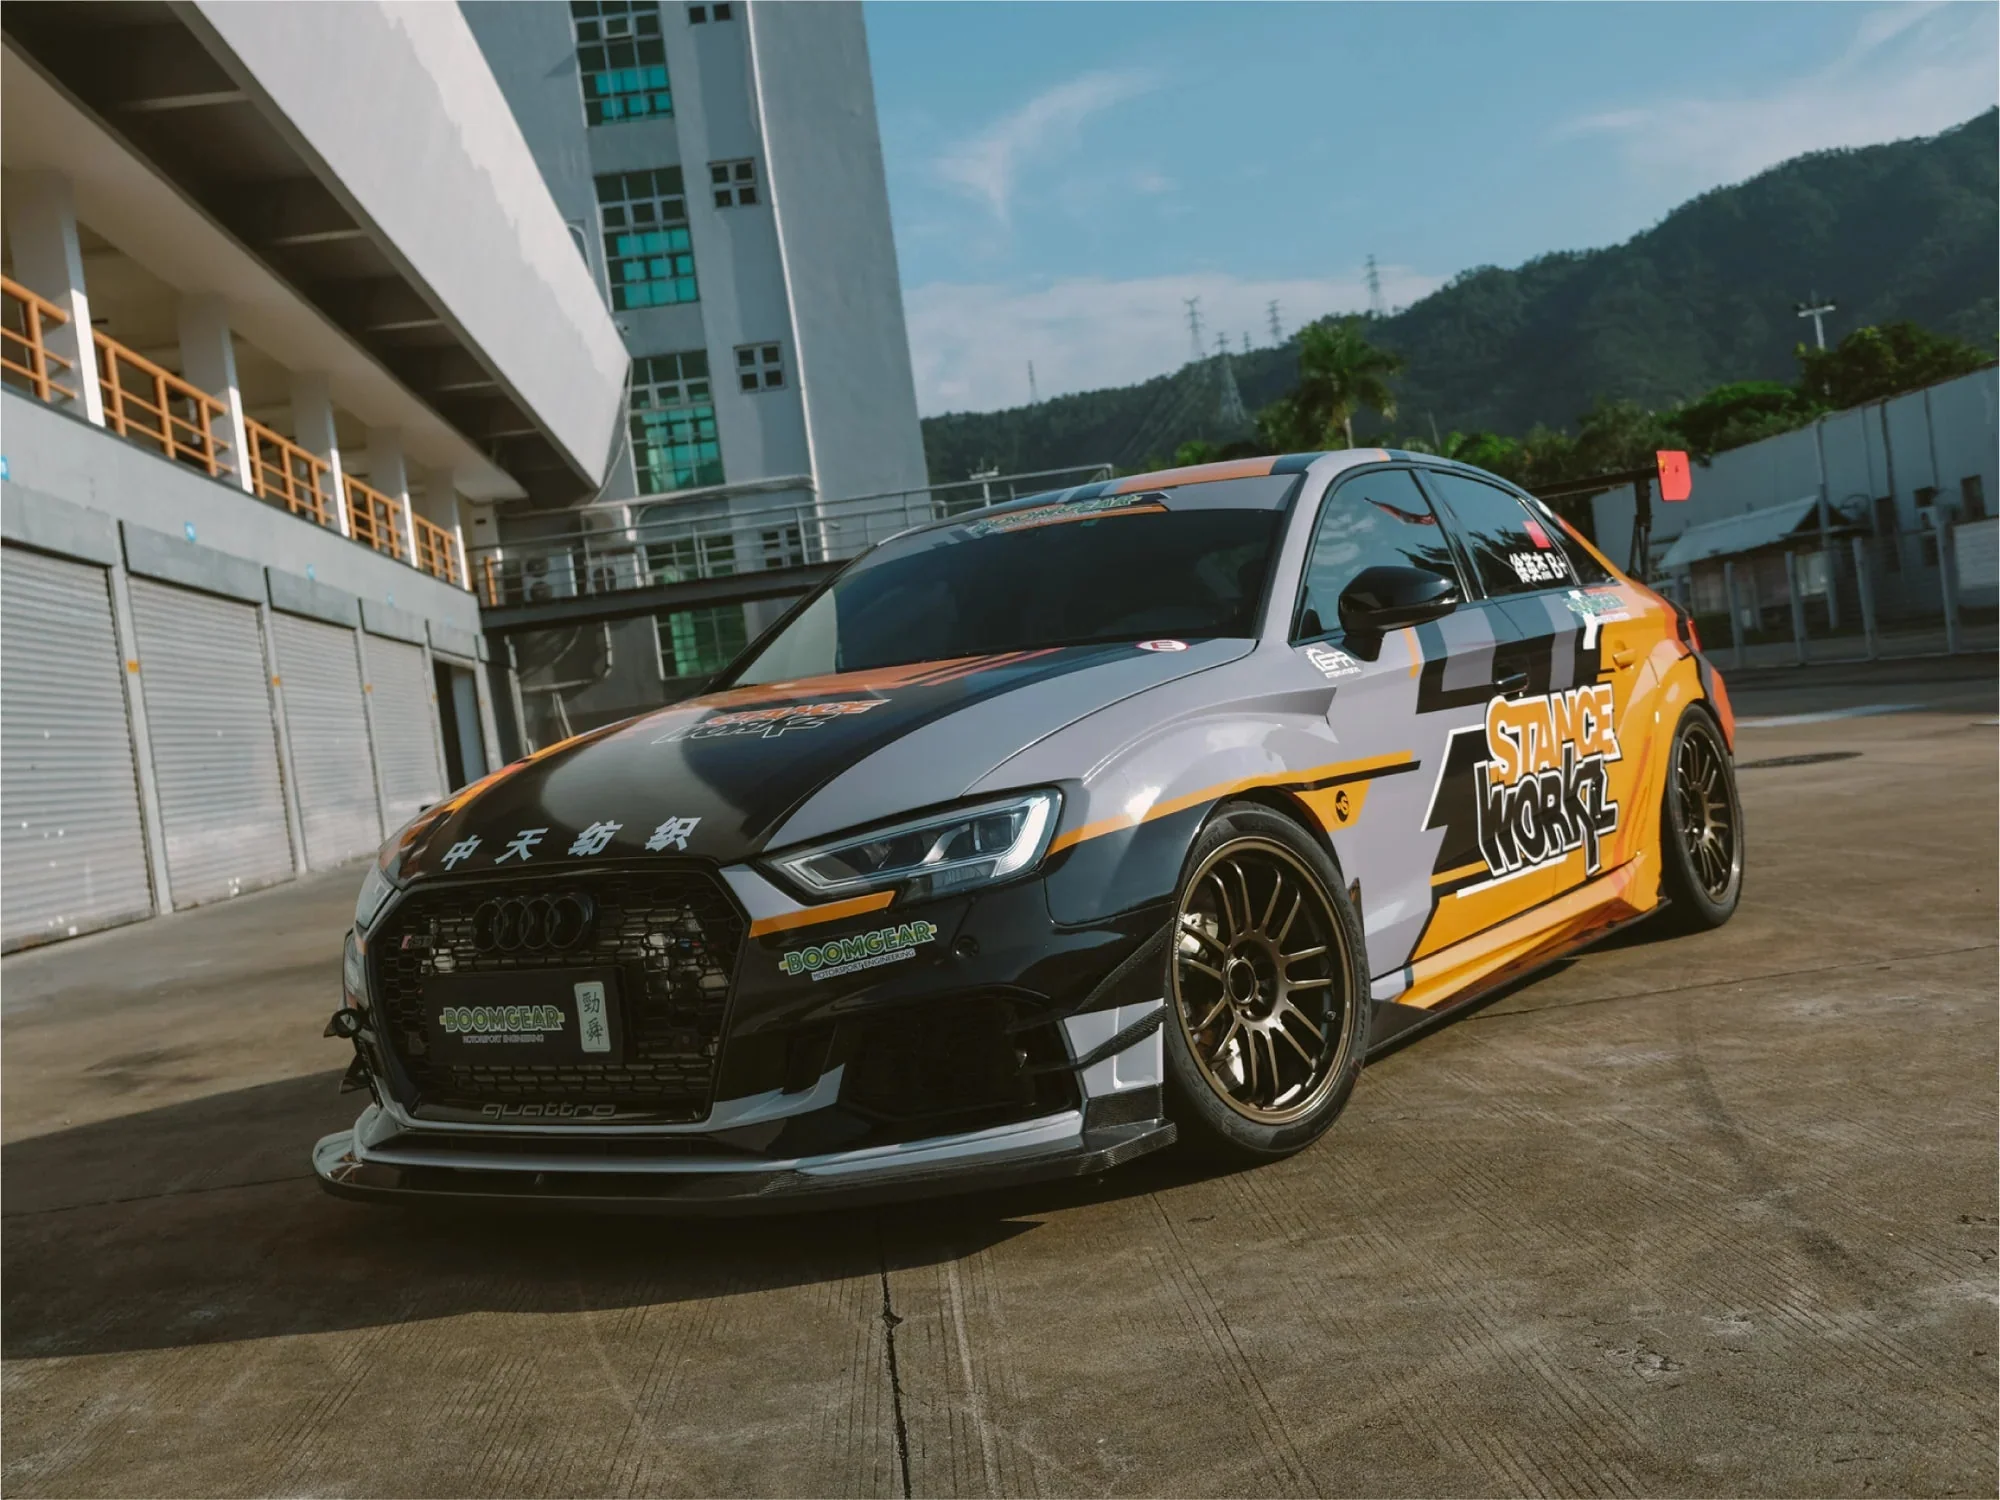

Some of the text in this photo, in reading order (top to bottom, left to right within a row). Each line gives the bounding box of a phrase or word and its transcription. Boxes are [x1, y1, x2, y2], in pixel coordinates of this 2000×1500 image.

[1486, 683, 1622, 786] STANCE
[1474, 741, 1618, 876] WORKZ
[441, 816, 702, 871] 中天纺织
[780, 920, 938, 976] BOOMGEAR
[812, 949, 916, 981] MOTORSPORT ENGINEERING
[440, 1005, 565, 1033] BOOMGEAR
[482, 1101, 616, 1120] quattro
